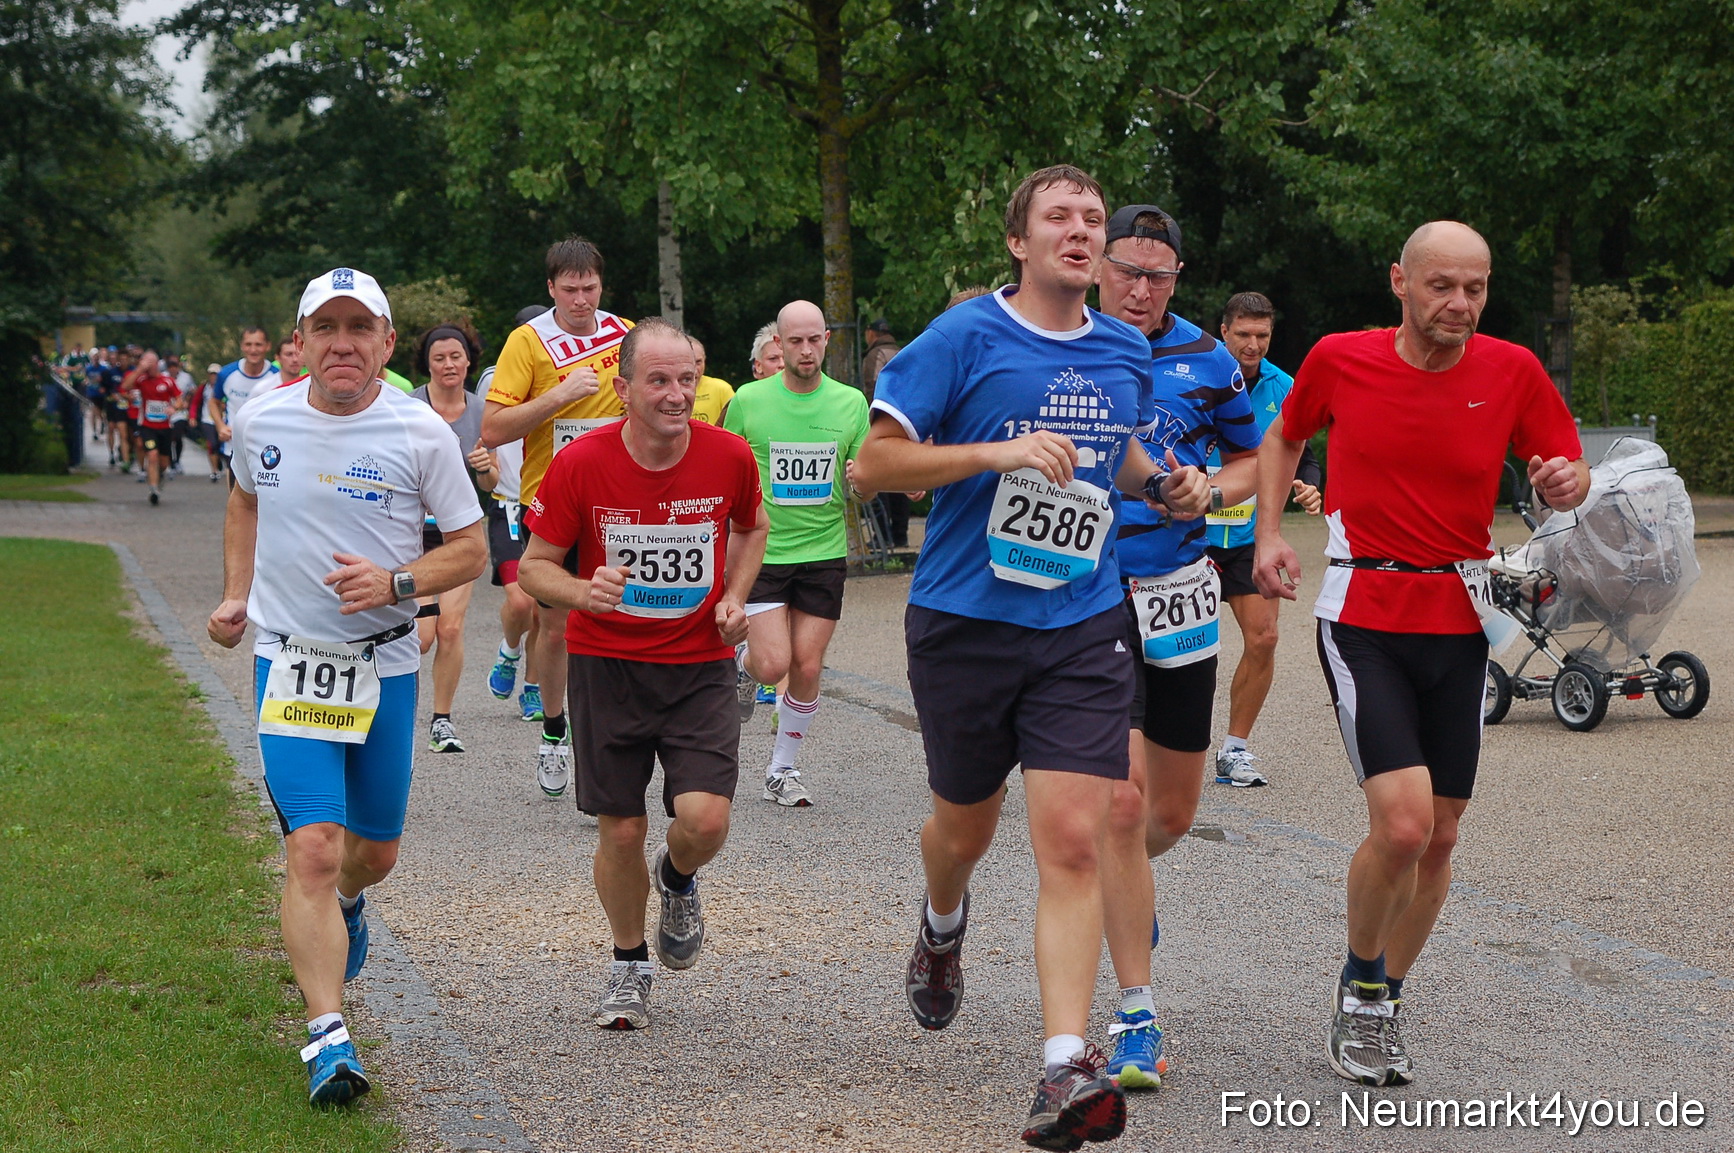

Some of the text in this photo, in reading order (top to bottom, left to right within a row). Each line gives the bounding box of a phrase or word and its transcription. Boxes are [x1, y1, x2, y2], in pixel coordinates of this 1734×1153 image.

[555, 424, 579, 432] PARTL
[1034, 420, 1091, 432] Neumarkter
[1100, 435, 1116, 443] 2012
[256, 471, 280, 482] PARTL
[776, 458, 832, 481] 3047
[318, 474, 336, 485] 14.
[787, 487, 820, 497] Norbert
[1003, 473, 1098, 507] PARTL Neumarkt
[658, 496, 724, 510] 11. NEUMARKTER
[670, 505, 714, 516] STADTLAUF
[600, 514, 632, 525] IMMER
[1000, 494, 1100, 552] 2586
[608, 534, 644, 544] PARTL
[647, 535, 696, 544] Neumarkt
[618, 548, 704, 582] 2533
[1008, 548, 1071, 577] Clemens
[1134, 584, 1168, 594] PARTL
[633, 590, 684, 606] Werner
[1148, 580, 1216, 632] 2615
[1176, 632, 1206, 651] Horst
[290, 660, 356, 702] 191
[283, 705, 355, 729] Christoph
